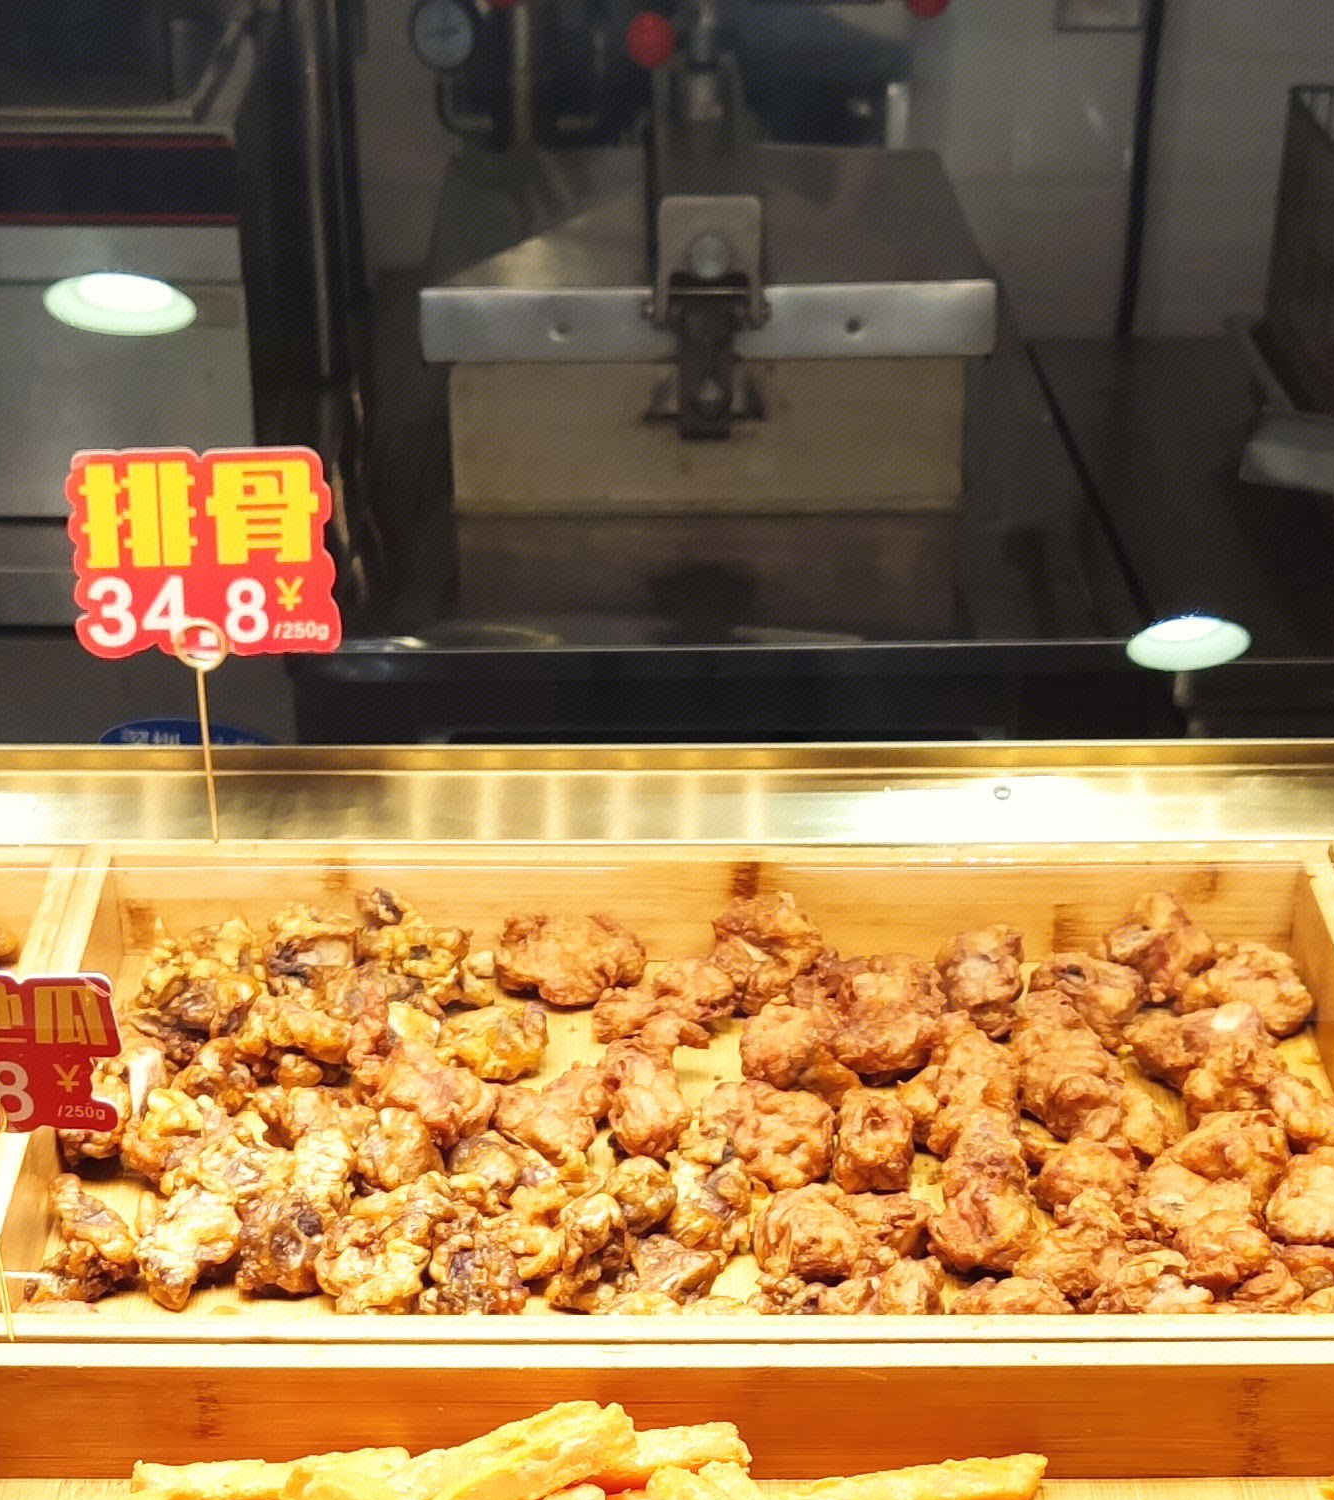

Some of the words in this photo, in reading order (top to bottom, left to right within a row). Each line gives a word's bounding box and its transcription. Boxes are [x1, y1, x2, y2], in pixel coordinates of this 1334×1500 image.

[79, 459, 319, 569] 排骨
[87, 574, 269, 648] 34.8
[57, 1102, 107, 1121] /250g
